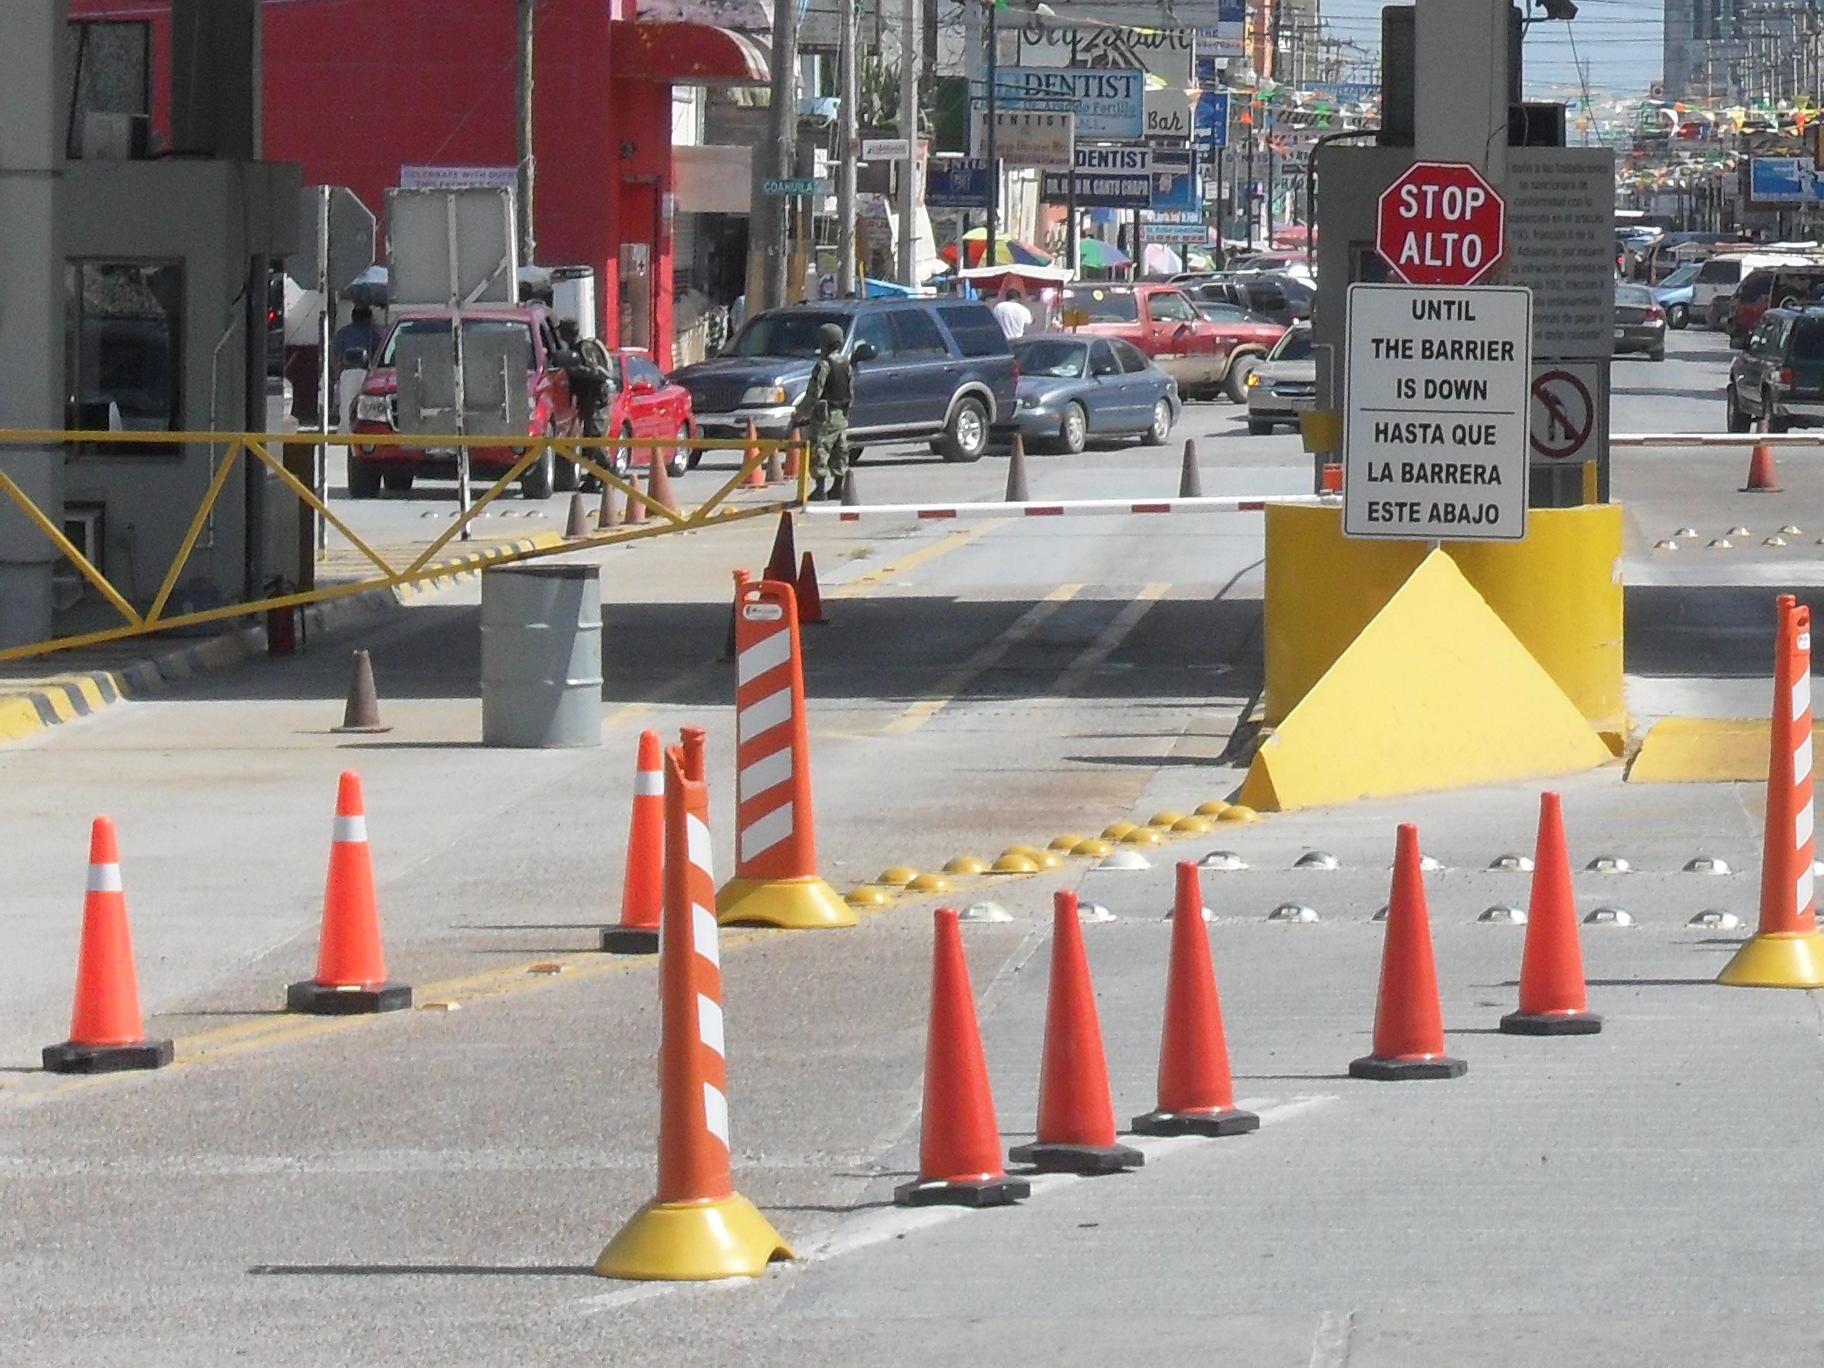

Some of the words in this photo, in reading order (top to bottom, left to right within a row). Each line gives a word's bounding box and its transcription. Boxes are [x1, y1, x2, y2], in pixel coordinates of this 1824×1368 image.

[1023, 72, 1138, 98] DENTIST
[1148, 110, 1184, 131] Bar
[1077, 149, 1149, 169] DENTIST
[1399, 184, 1486, 221] STOP
[1399, 232, 1484, 268] ALTO
[1411, 298, 1476, 322] UNTIL
[1371, 338, 1414, 361] THE
[1420, 338, 1516, 362] BARRIER
[1396, 377, 1417, 400] IS
[1423, 378, 1488, 401] DOWN
[1373, 421, 1445, 445] HASTA
[1451, 423, 1498, 447] QUE
[1366, 461, 1396, 484] LA
[1400, 462, 1502, 486] BARRERA
[1367, 500, 1421, 524] ESTE
[1427, 501, 1500, 526] ABAJO
